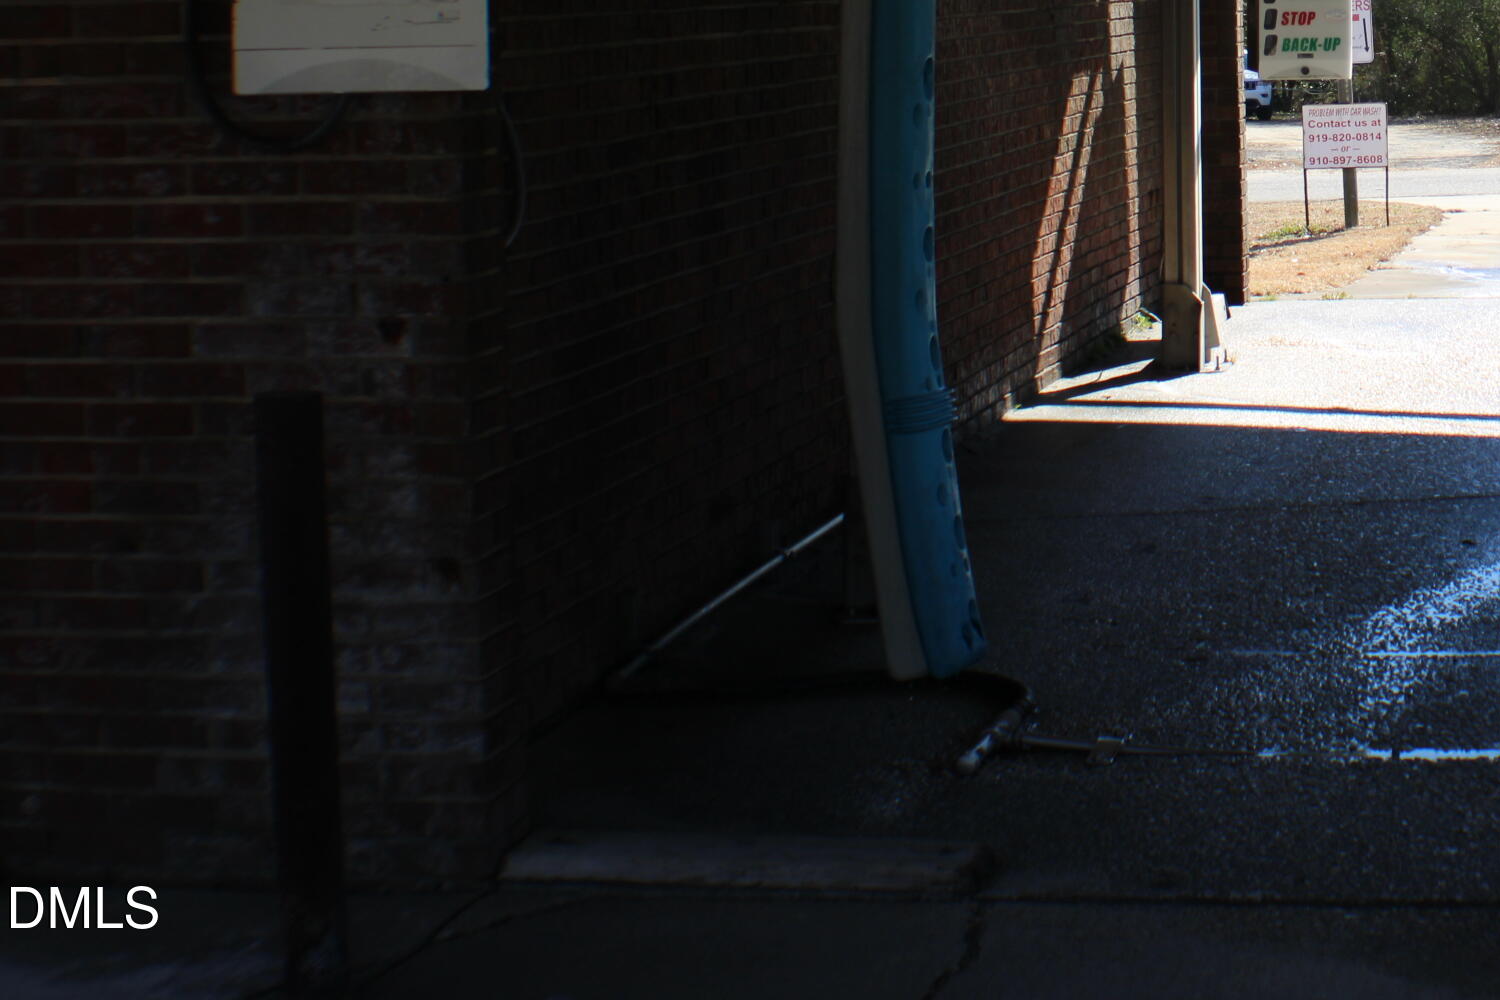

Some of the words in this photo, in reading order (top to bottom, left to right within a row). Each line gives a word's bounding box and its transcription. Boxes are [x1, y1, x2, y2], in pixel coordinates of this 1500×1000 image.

[1281, 11, 1316, 26] STOP
[1281, 37, 1342, 53] BACK-UP
[1308, 108, 1335, 117] PROBLEM
[1335, 108, 1349, 116] WITH
[1350, 108, 1362, 116] CAR
[1308, 119, 1351, 128] Contact
[1371, 119, 1381, 127] at
[1308, 132, 1382, 142] 919-820-0814
[1309, 155, 1383, 165] 910-897-8608
